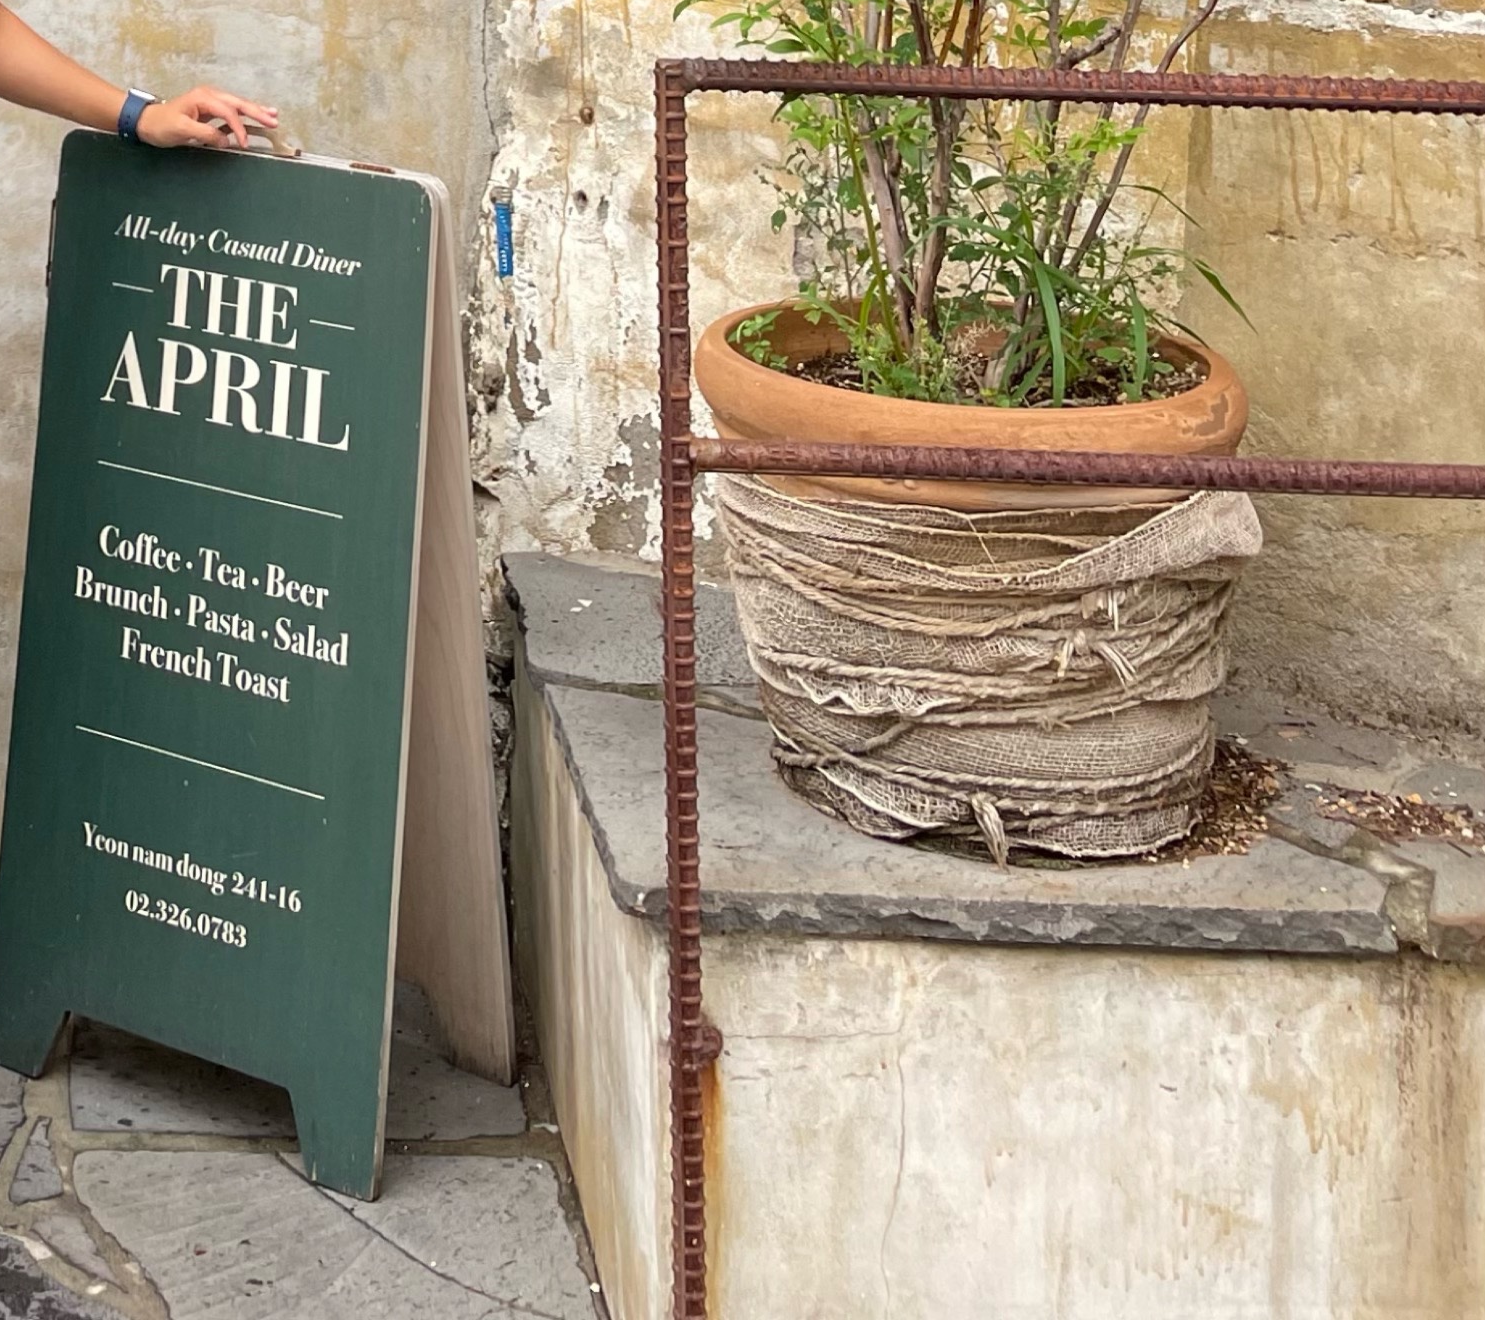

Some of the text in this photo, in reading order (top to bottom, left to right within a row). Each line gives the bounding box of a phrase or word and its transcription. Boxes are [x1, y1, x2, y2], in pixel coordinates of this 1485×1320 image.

[115, 214, 362, 277] All-day Casual Diner
[160, 263, 299, 350] THE
[100, 330, 350, 452] APRIL
[99, 524, 329, 610] Coffee Tea Beer
[74, 565, 349, 667] Brunch Pasta Salad
[119, 626, 291, 703] French Toast
[132, 841, 173, 874] nam
[176, 853, 228, 896] dong
[231, 871, 302, 913] 241-16
[124, 889, 248, 949] 02.326.0783
